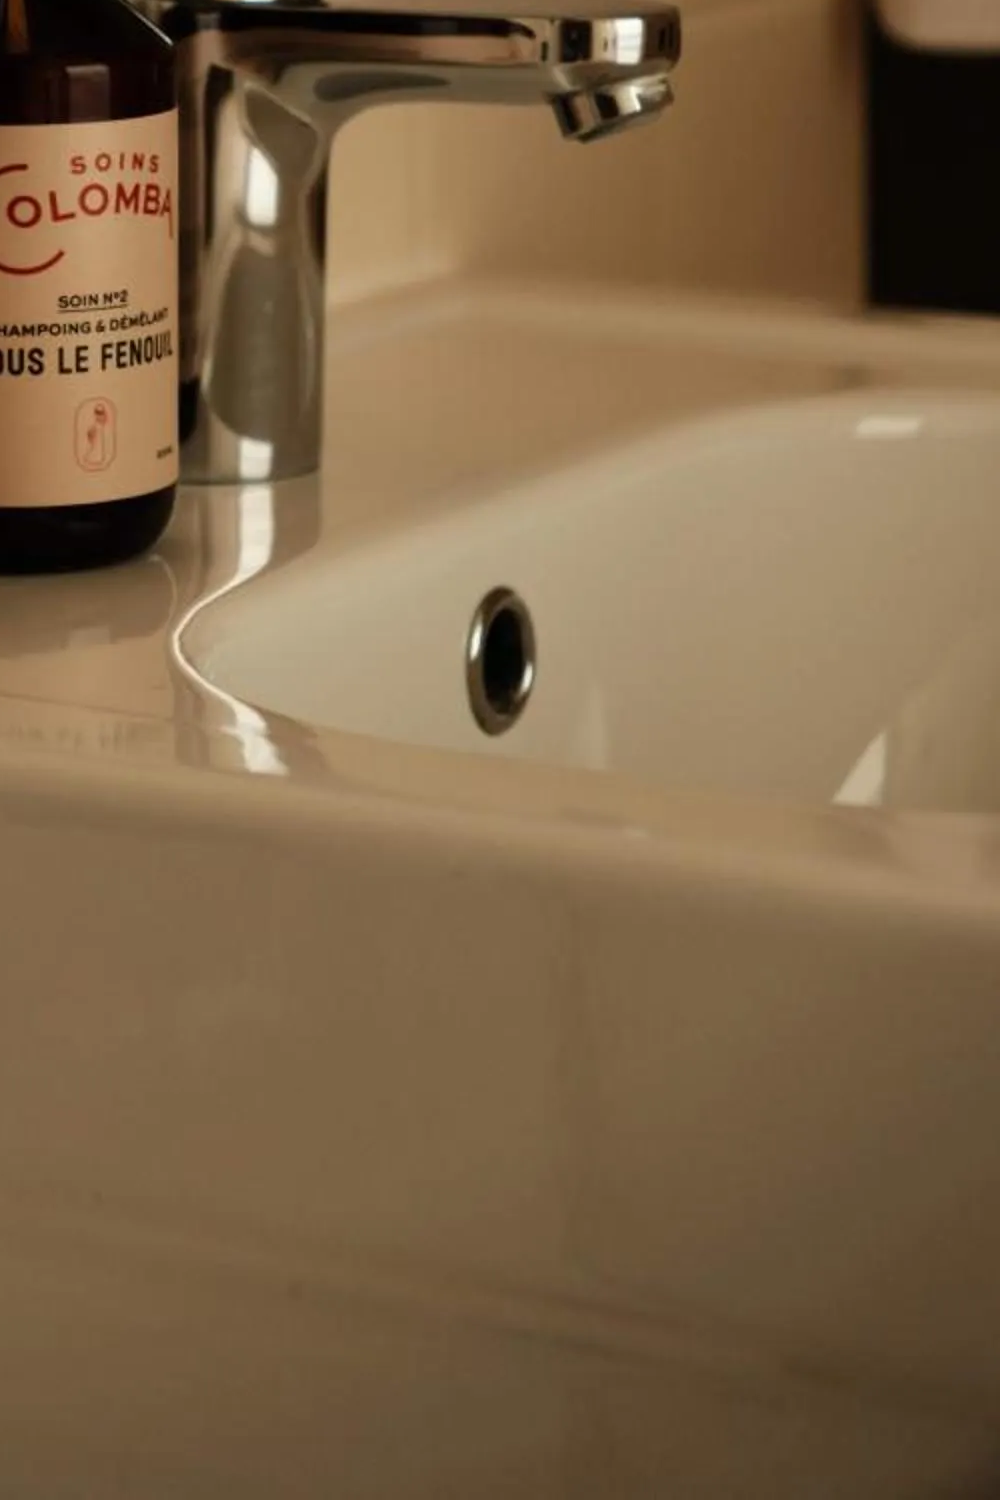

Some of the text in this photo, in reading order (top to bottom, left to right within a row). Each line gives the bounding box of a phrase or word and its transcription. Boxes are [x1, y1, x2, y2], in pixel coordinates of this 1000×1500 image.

[70, 153, 159, 175] SOINS
[57, 294, 99, 309] SOIN
[96, 320, 105, 333] &
[57, 346, 89, 374] LE
[101, 329, 174, 371] FENOUIL
